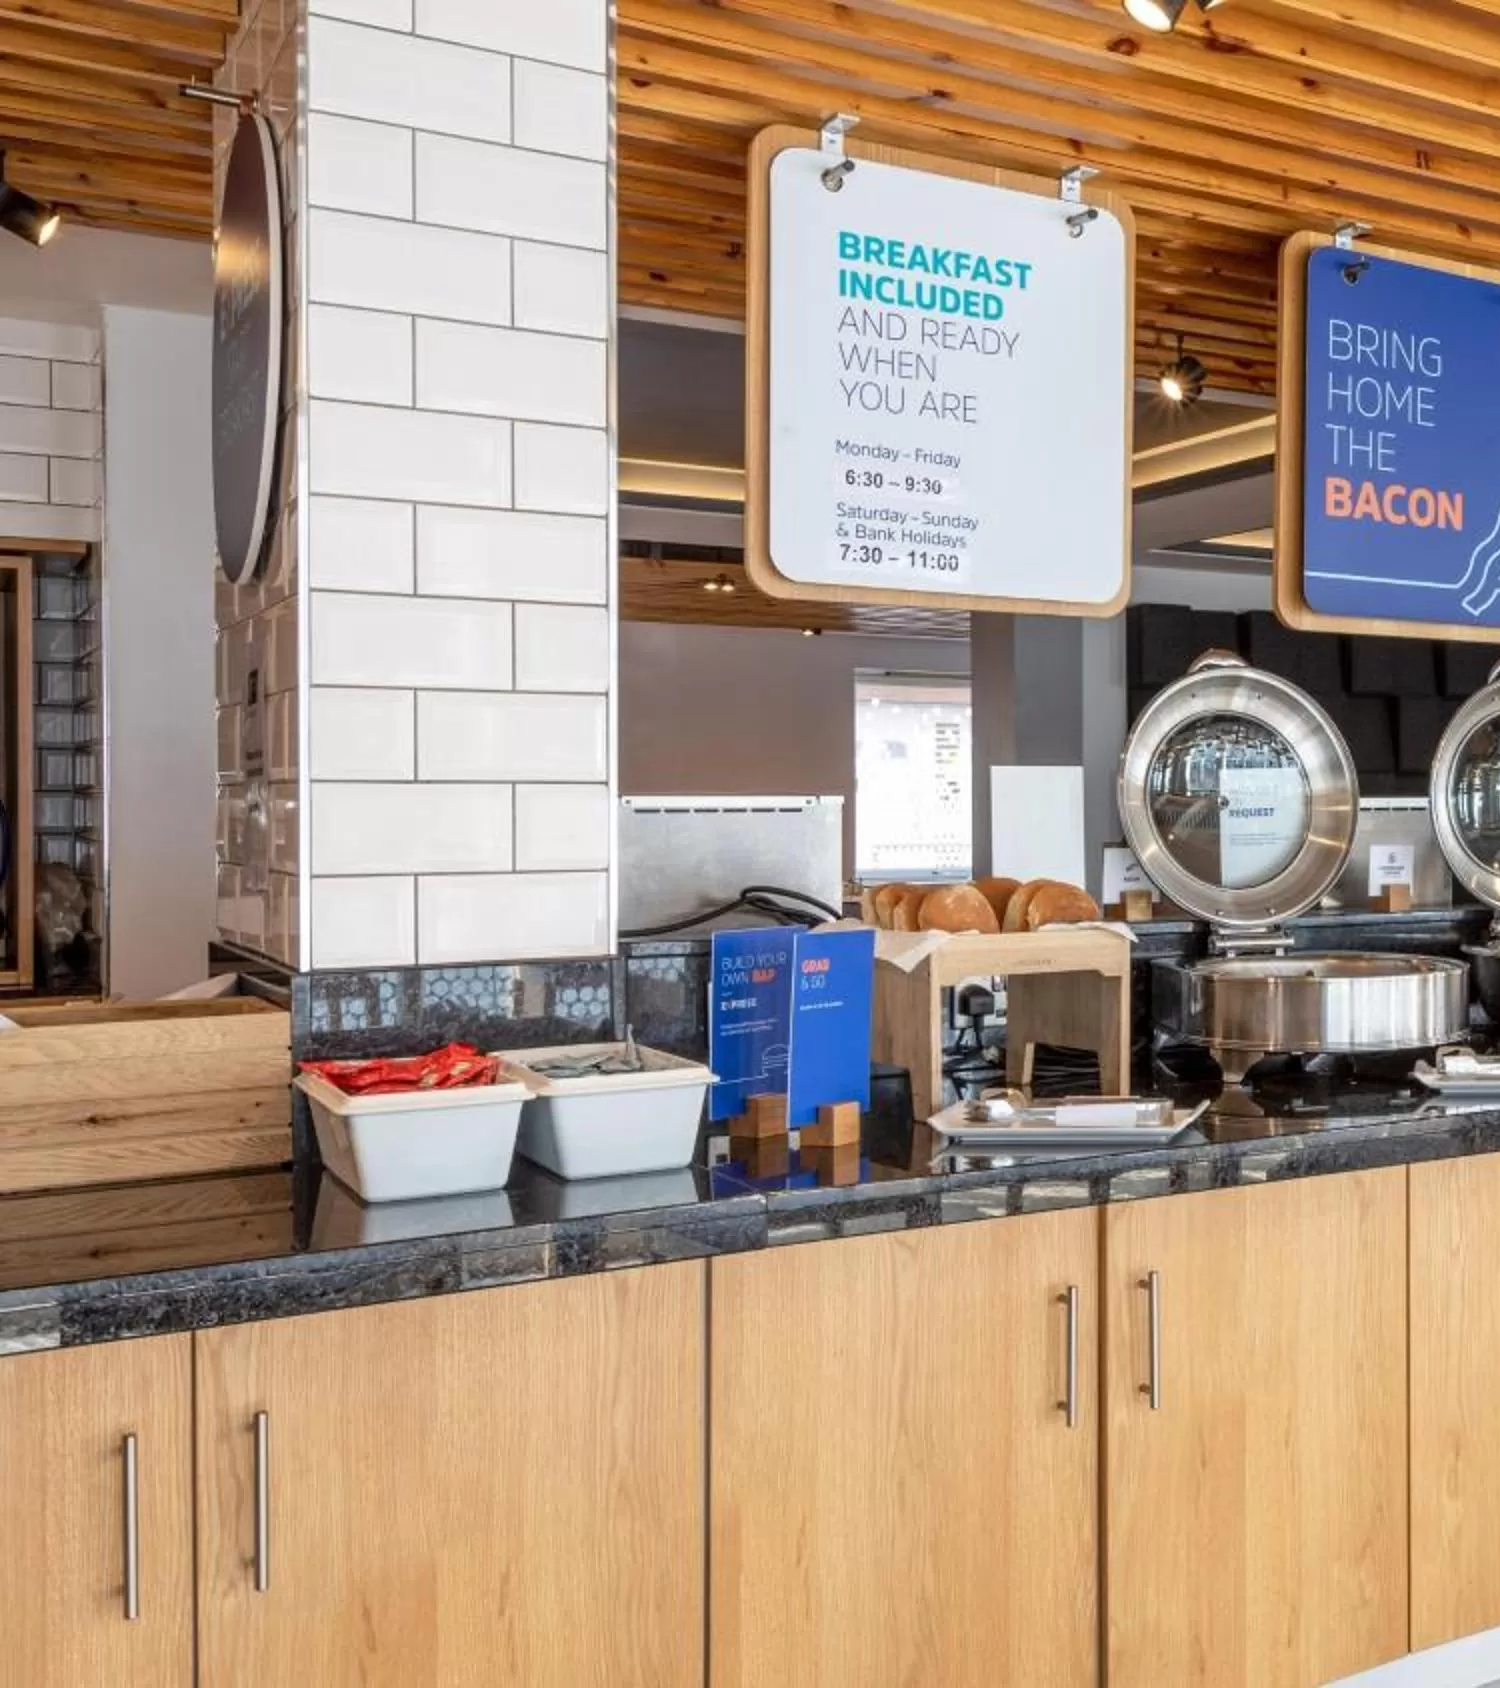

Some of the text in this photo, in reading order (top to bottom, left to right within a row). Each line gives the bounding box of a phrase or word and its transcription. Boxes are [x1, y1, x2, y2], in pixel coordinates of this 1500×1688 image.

[838, 231, 1032, 289] BREAKFAST
[838, 269, 1003, 320] INCLUDED
[838, 306, 1021, 357] AND READY
[1328, 319, 1442, 377] BRING
[838, 343, 937, 382] WHEN
[840, 380, 979, 424] YOU ARE
[1327, 372, 1436, 428] HOME
[835, 439, 899, 462] Monday
[915, 448, 960, 468] Friday
[1325, 423, 1396, 473] THE
[845, 469, 883, 488] 6:30
[905, 476, 942, 494] 9:30
[1325, 476, 1463, 531] BACON
[835, 522, 967, 548] & Bank Holidays
[836, 501, 908, 525] Saturday
[921, 511, 979, 531] Sunday
[839, 543, 882, 564] 7:30
[907, 551, 959, 572] 11:00
